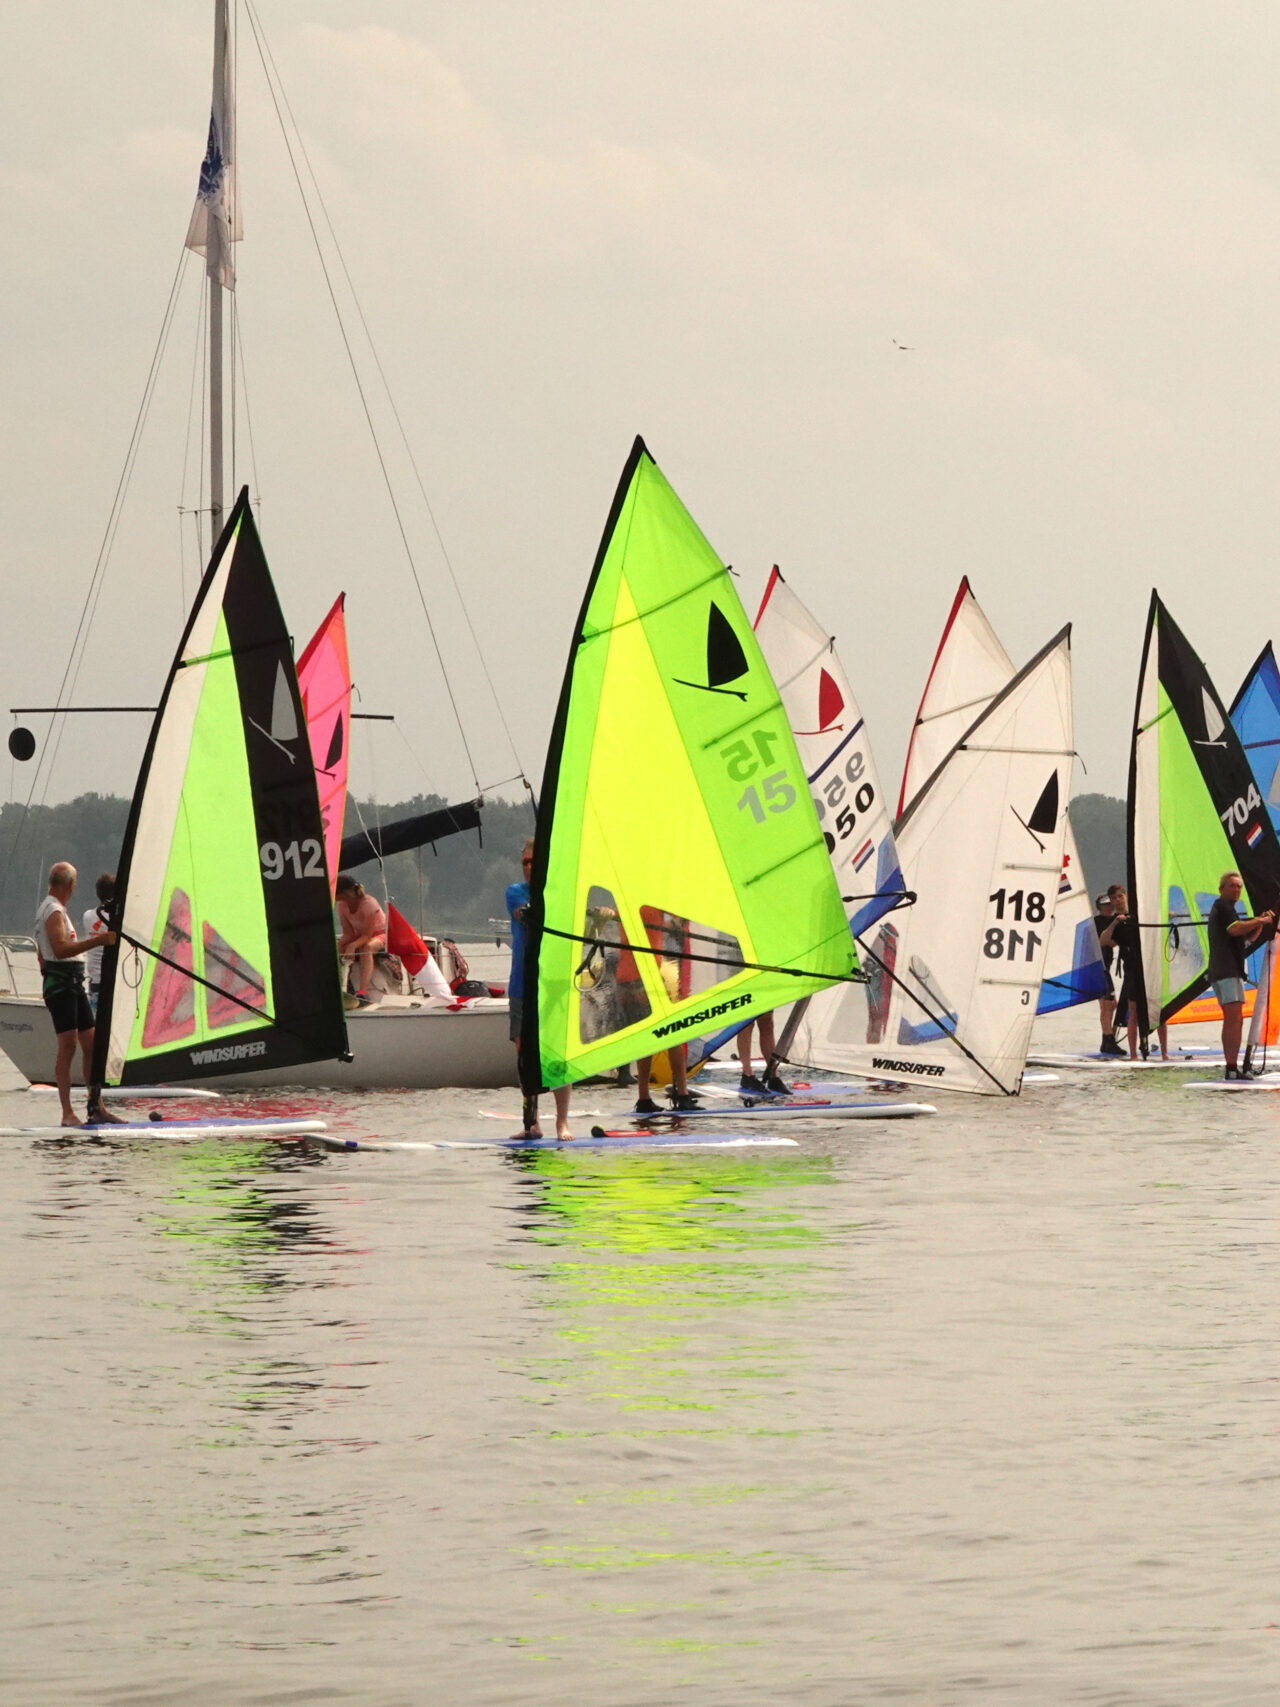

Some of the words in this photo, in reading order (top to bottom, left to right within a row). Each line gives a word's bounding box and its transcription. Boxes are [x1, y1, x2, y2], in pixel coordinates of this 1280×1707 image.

[737, 769, 797, 825] 15
[1220, 782, 1262, 837] 704
[259, 838, 325, 881] 912
[989, 887, 1047, 924] 118
[651, 993, 752, 1039] WINDSURFER
[190, 1041, 267, 1066] WINDSURFER
[872, 1057, 945, 1077] WINDSURFER
